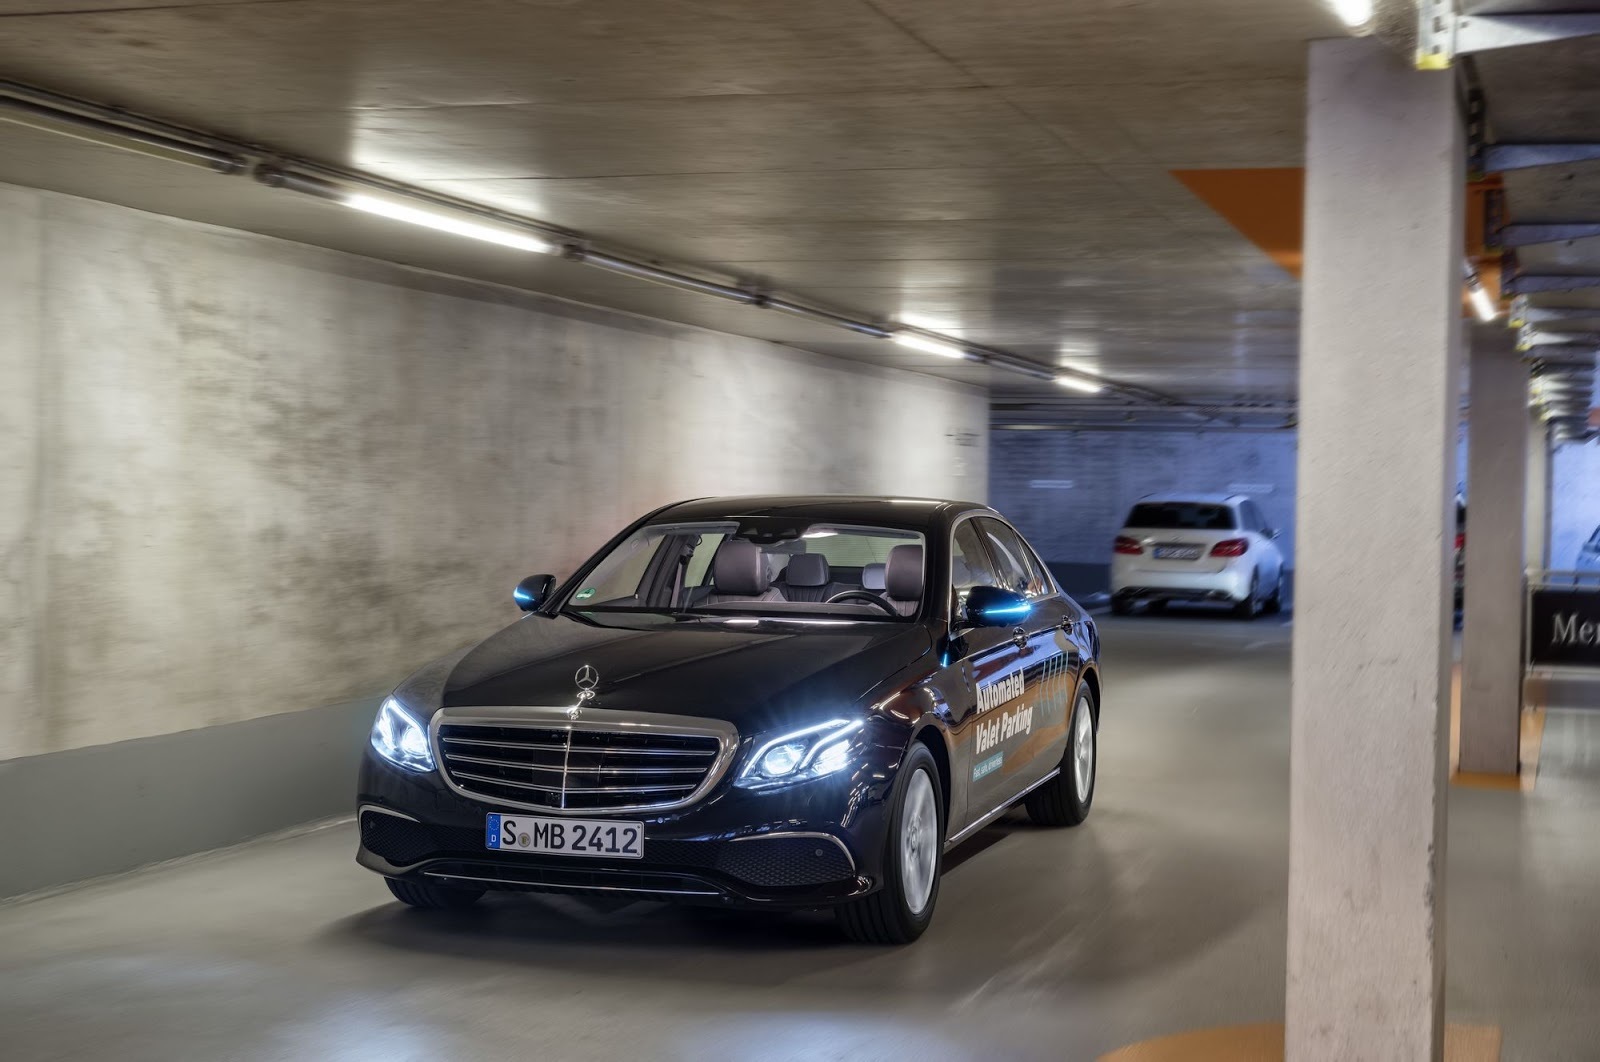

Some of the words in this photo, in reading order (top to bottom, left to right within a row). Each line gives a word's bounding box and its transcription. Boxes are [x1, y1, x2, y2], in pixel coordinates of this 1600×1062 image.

[976, 666, 1025, 714] Automated
[976, 717, 1000, 754] Valet
[1000, 703, 1033, 742] Parking
[502, 820, 517, 845] S
[533, 822, 565, 849] MB
[571, 825, 637, 853] 2412
